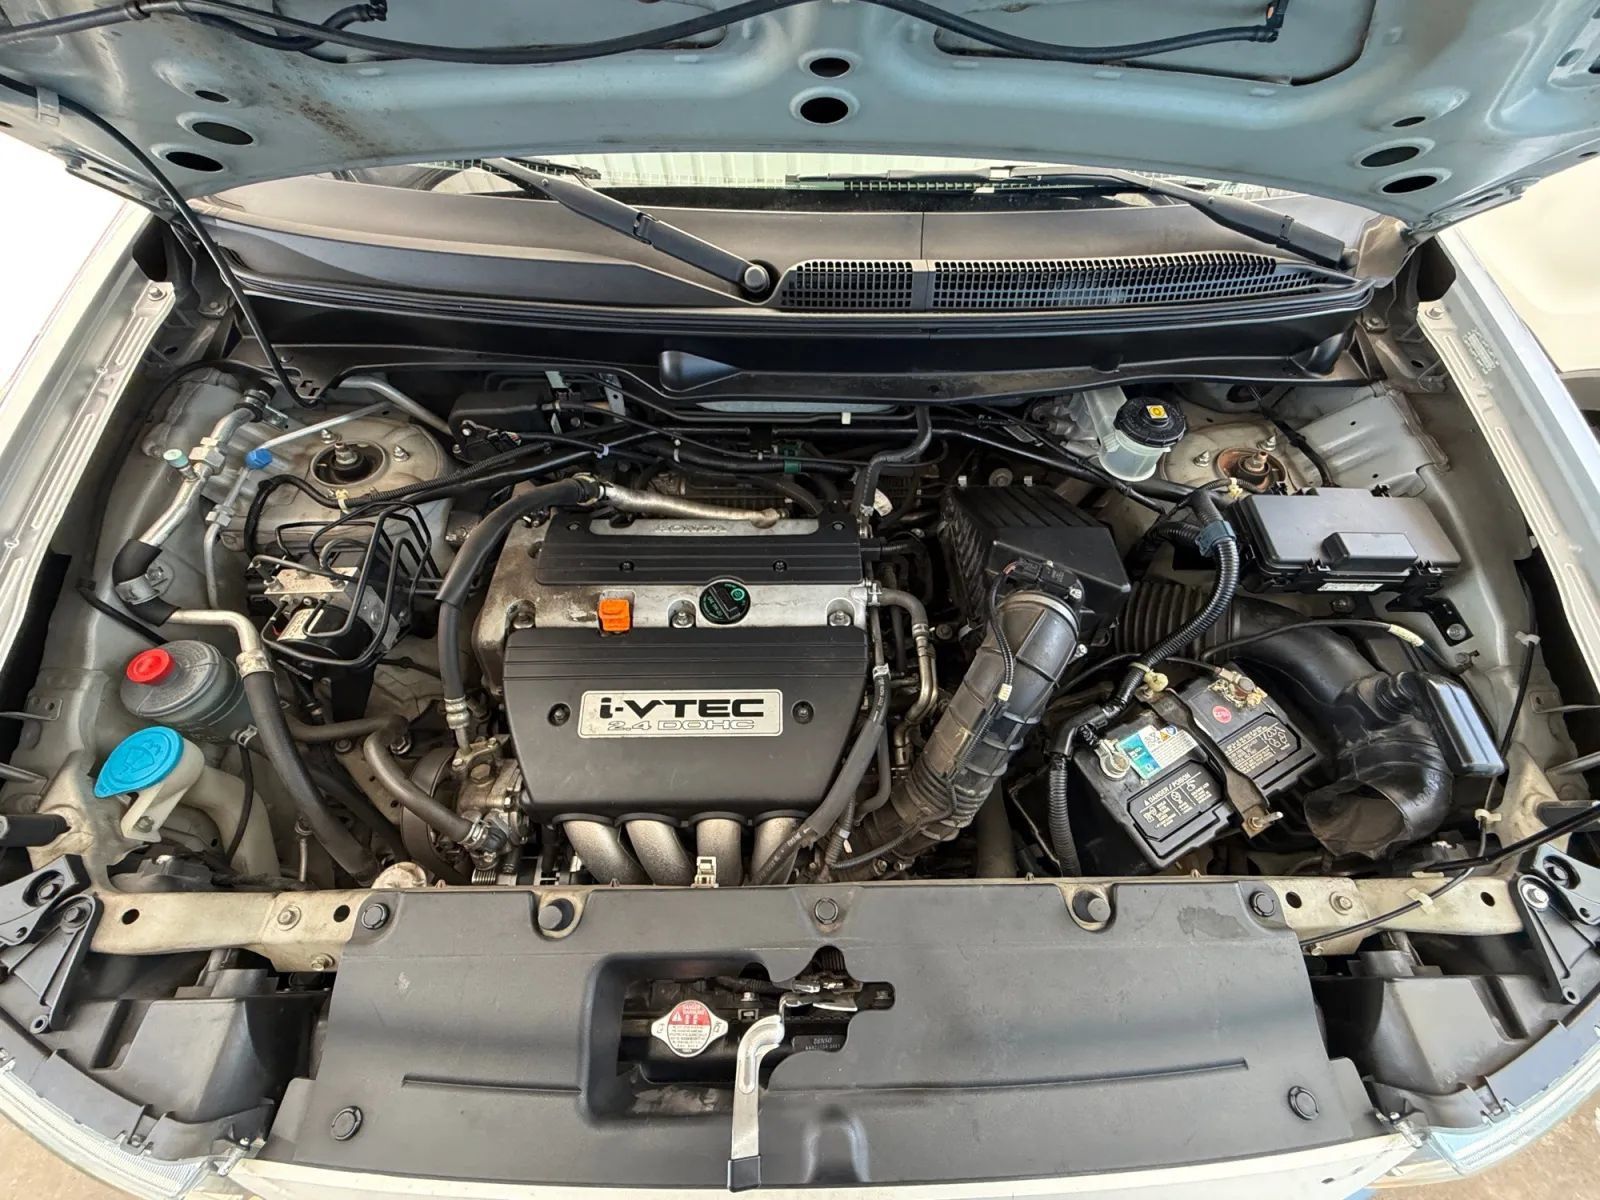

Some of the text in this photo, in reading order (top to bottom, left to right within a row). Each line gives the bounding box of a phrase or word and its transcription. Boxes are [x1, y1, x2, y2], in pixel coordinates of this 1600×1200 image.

[600, 697, 764, 719] i-VTEC
[607, 720, 755, 731] 2.4 DOHC
[1148, 786, 1170, 802] DANGER
[1172, 772, 1191, 788] POISON
